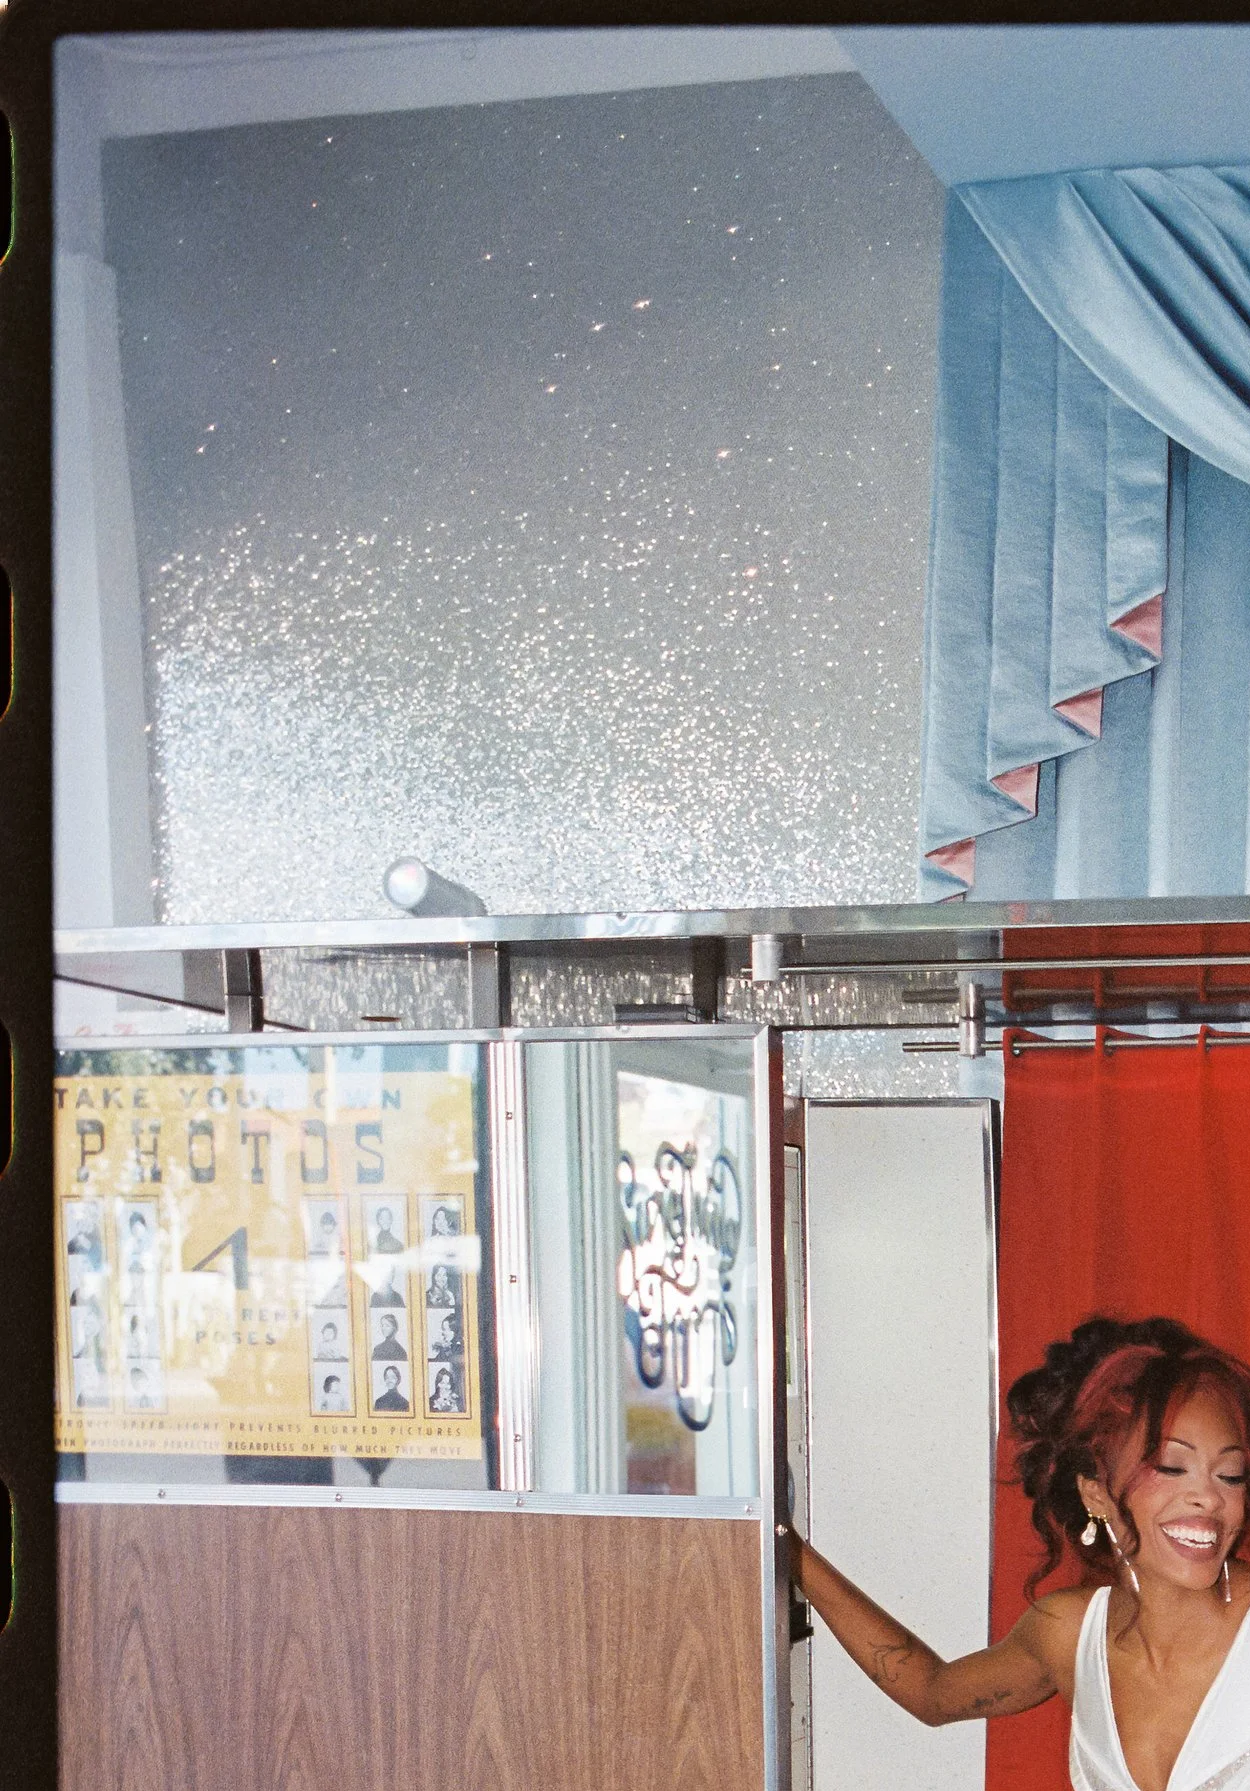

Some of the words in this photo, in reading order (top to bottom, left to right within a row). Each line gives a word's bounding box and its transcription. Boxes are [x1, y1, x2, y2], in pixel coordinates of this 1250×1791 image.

[54, 1087, 149, 1109] TAKE
[76, 1119, 384, 1184] PHOTOS
[191, 1226, 252, 1290] 4
[195, 1330, 276, 1346] POSES
[229, 1420, 301, 1433] PREVENTS
[313, 1423, 378, 1435] BLURRED
[390, 1426, 461, 1436] PICTURES
[227, 1441, 294, 1451] REGARDLESS
[301, 1443, 315, 1452] OF
[323, 1443, 348, 1453] HOW
[355, 1445, 388, 1454] MUCH
[395, 1445, 423, 1455] THEY
[430, 1446, 461, 1456] MOVE
